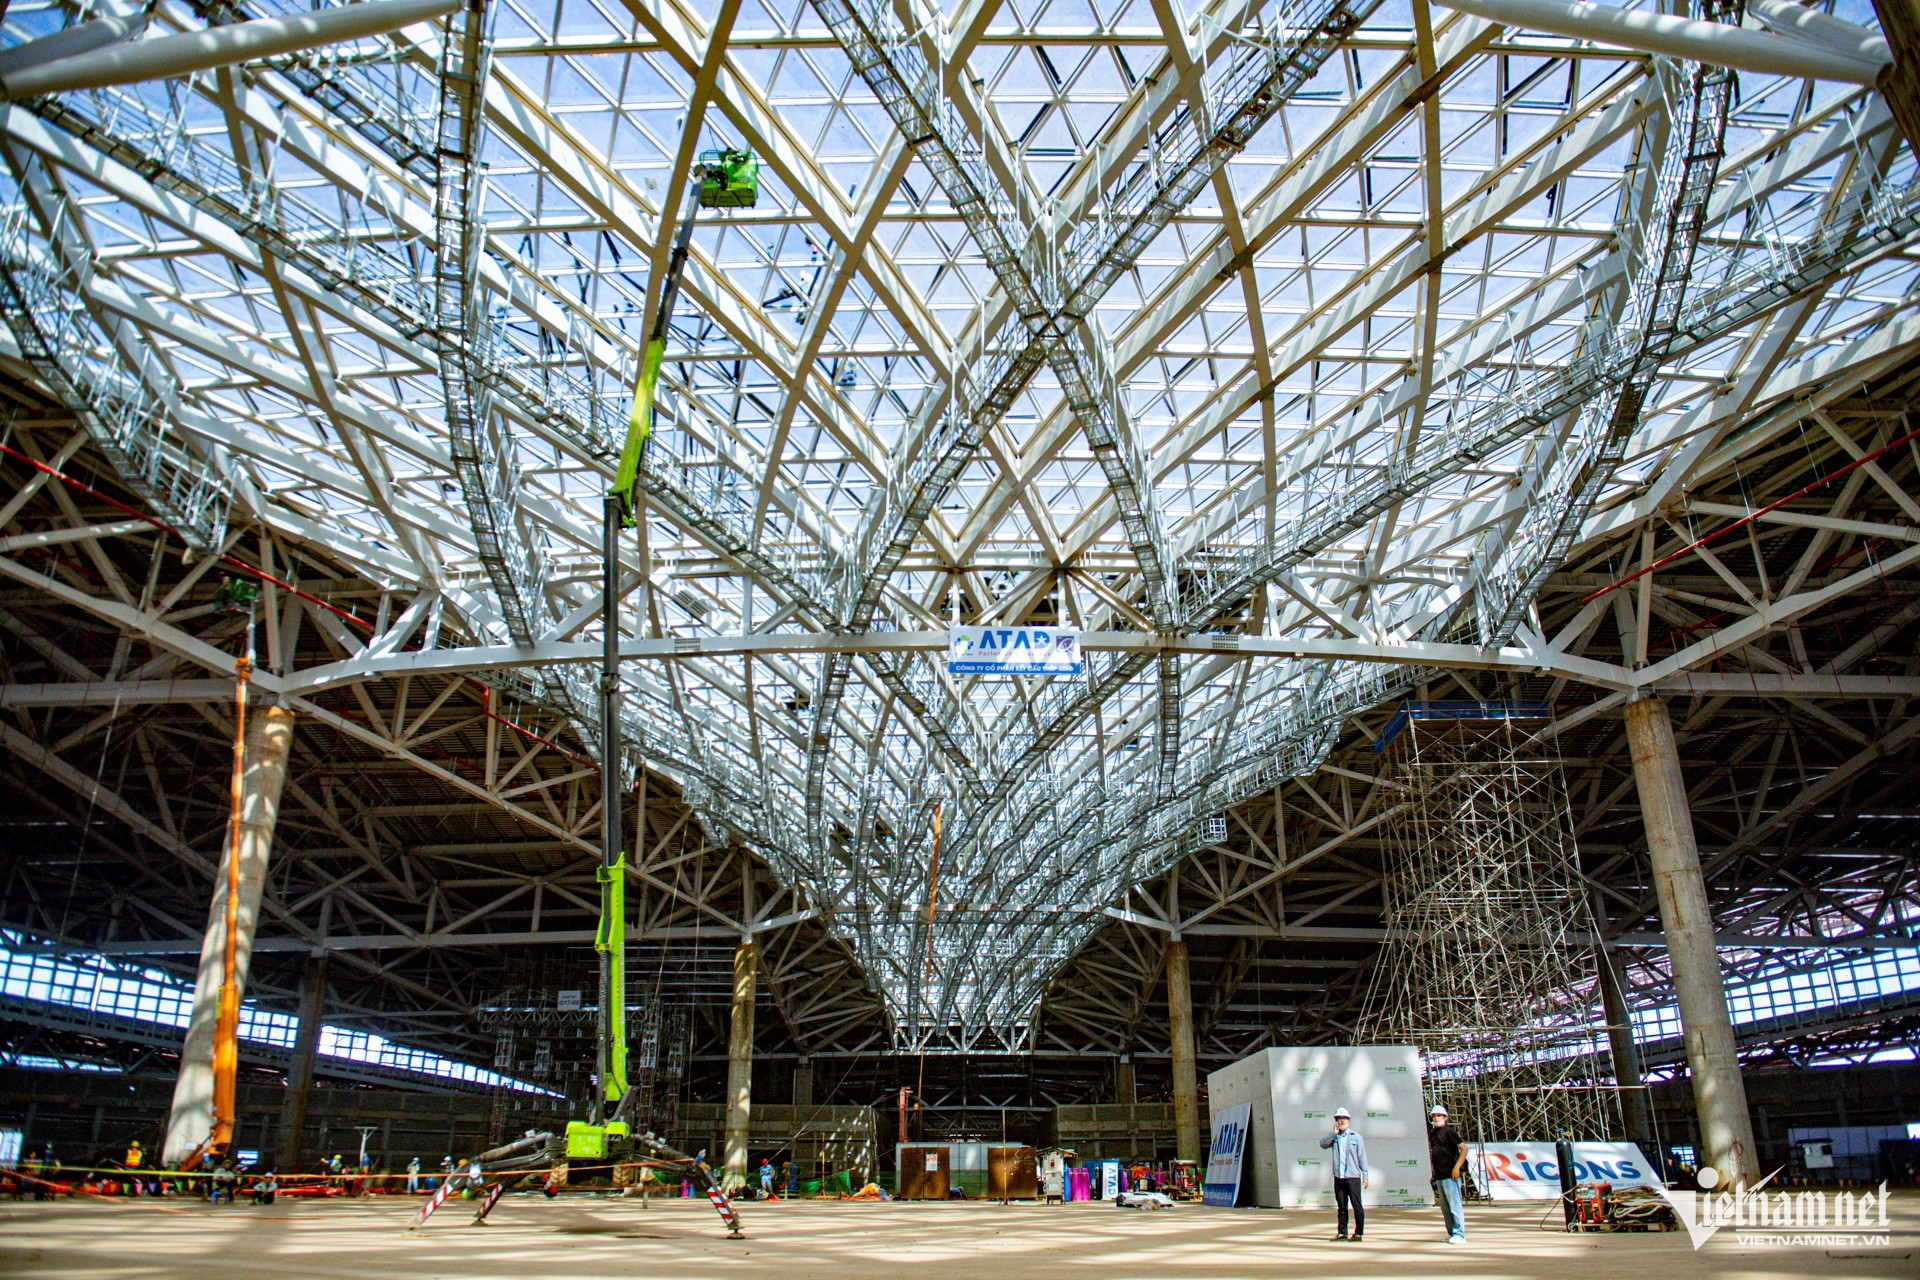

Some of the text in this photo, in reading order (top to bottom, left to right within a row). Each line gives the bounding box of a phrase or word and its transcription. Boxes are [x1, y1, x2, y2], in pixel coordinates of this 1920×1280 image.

[979, 630, 1050, 649] ATAD
[1216, 1122, 1238, 1155] ATAD
[1108, 1168, 1116, 1195] ATAD
